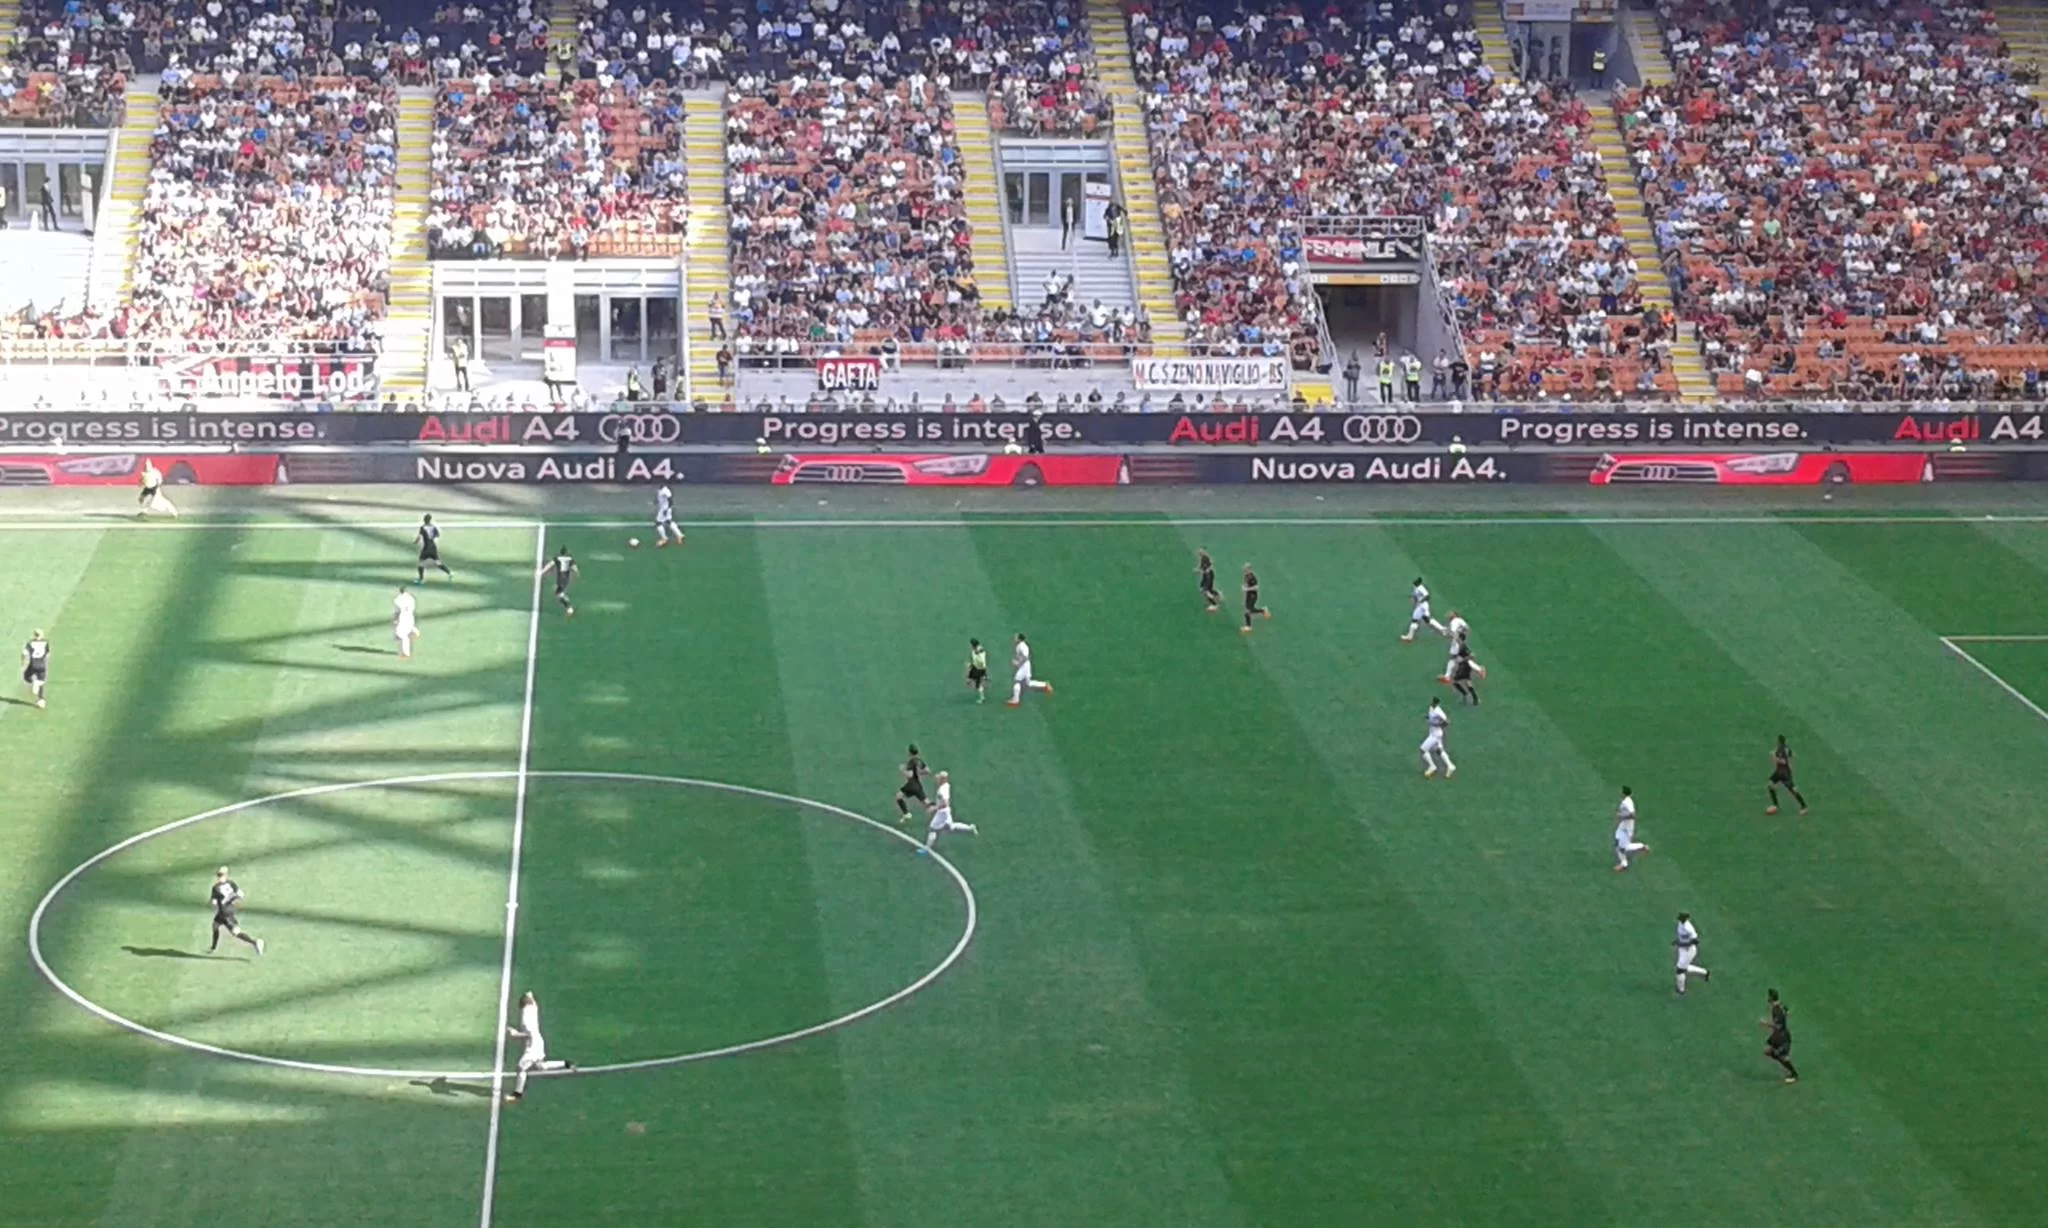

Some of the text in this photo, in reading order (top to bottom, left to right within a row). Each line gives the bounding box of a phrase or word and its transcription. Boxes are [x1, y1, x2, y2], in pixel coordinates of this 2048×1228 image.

[201, 362, 302, 396] Angelo
[822, 362, 877, 388] GAETA
[152, 417, 178, 438] is
[189, 417, 325, 438] intense.
[417, 415, 580, 442] Audi A4
[763, 417, 906, 442] Progress
[917, 417, 942, 438] is
[1168, 416, 1325, 442] Audi A4
[1501, 417, 1808, 443] Progress is intense.
[1894, 415, 2045, 441] Audi A4
[416, 457, 685, 480] Nuova Audi A4.
[1252, 457, 1507, 480] Nuova Audi A4.
